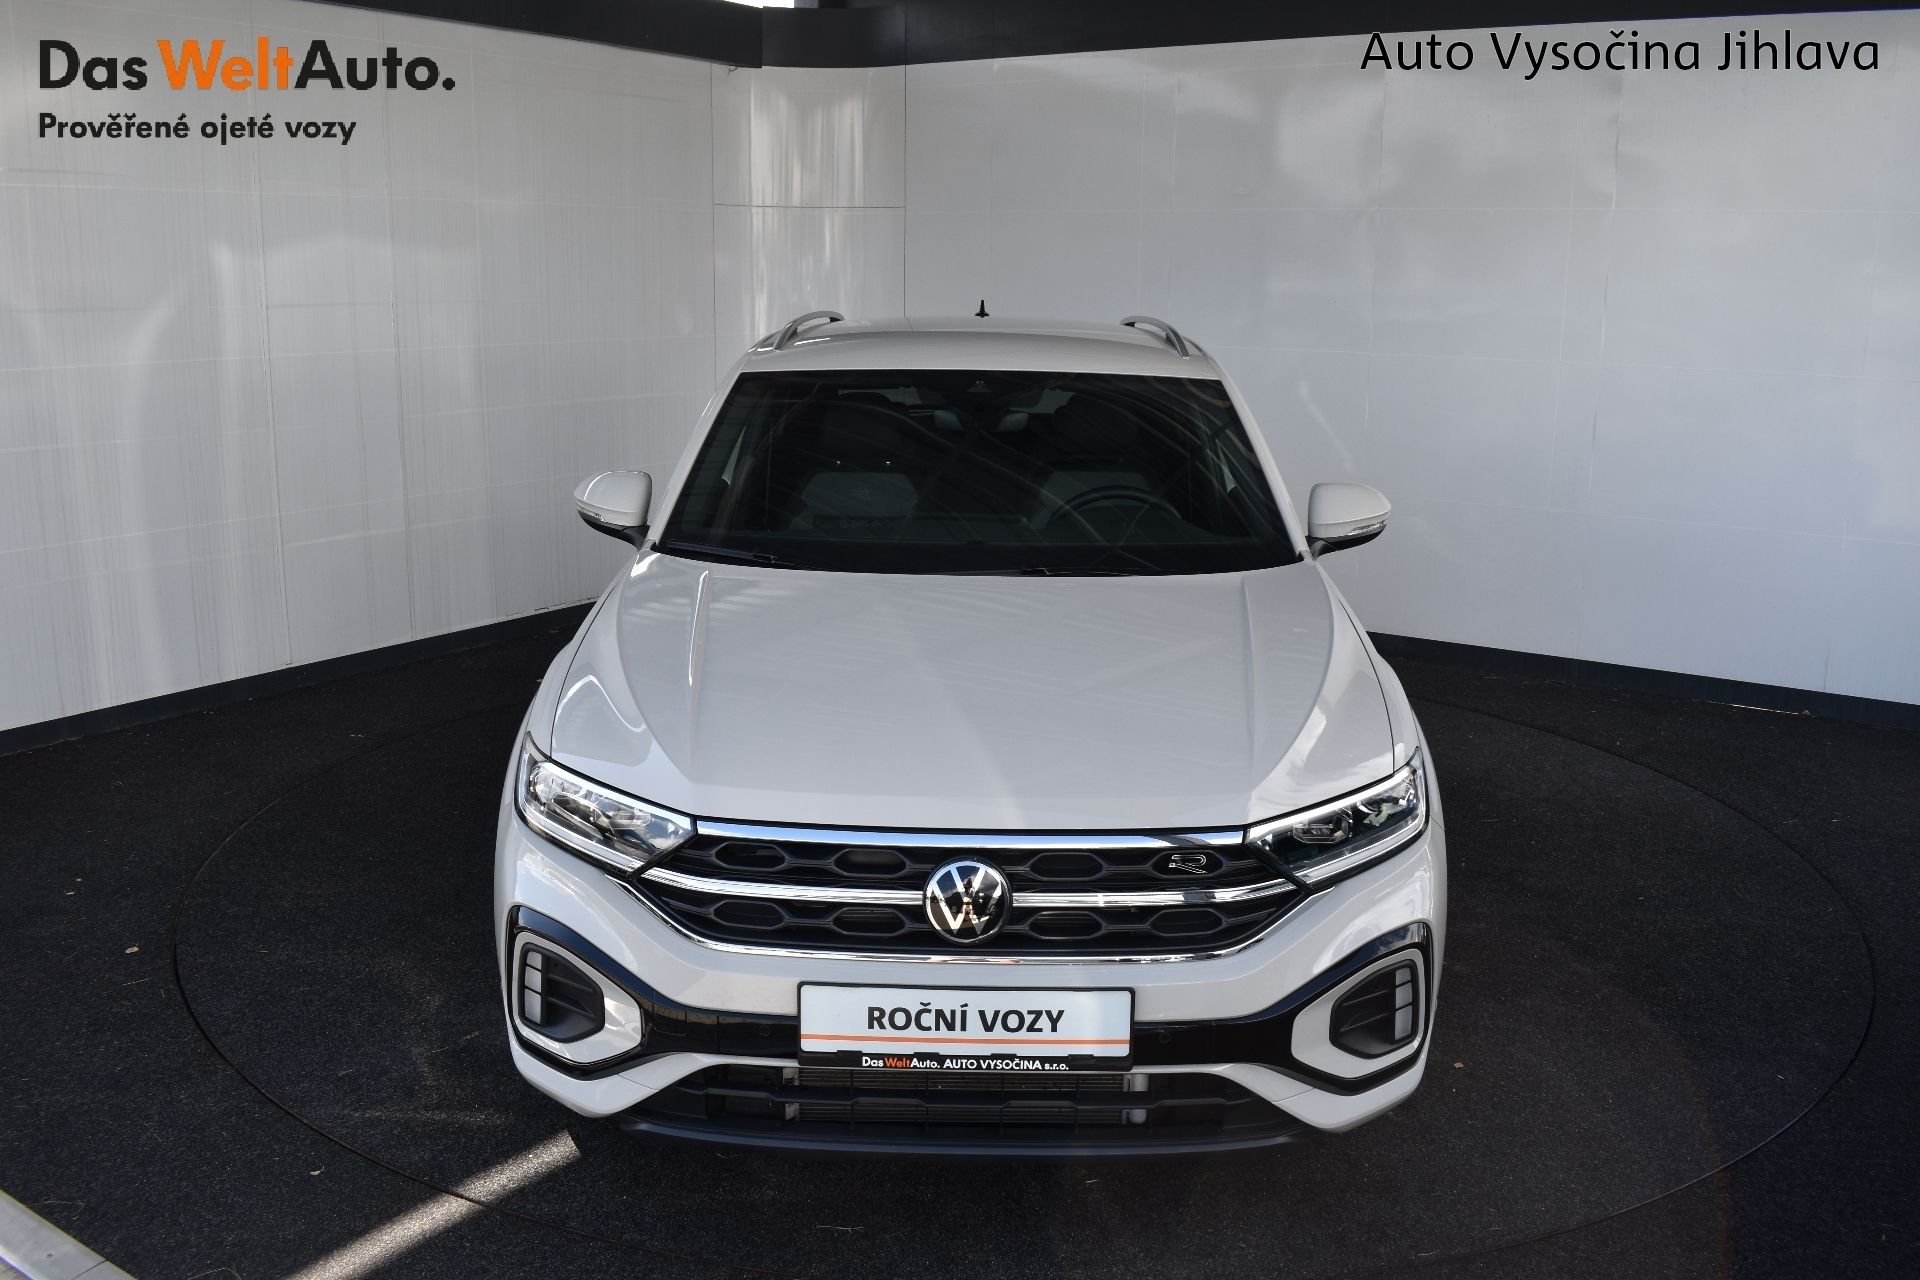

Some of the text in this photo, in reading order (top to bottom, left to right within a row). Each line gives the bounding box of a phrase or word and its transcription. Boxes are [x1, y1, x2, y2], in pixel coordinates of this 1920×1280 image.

[866, 1001, 1065, 1033] ROČNÍ VOZY
[862, 1056, 884, 1068] Das
[943, 1058, 977, 1070] AUTO
[980, 1057, 1043, 1070] VYSOČINA
[1044, 1061, 1069, 1071] s.r.o.
